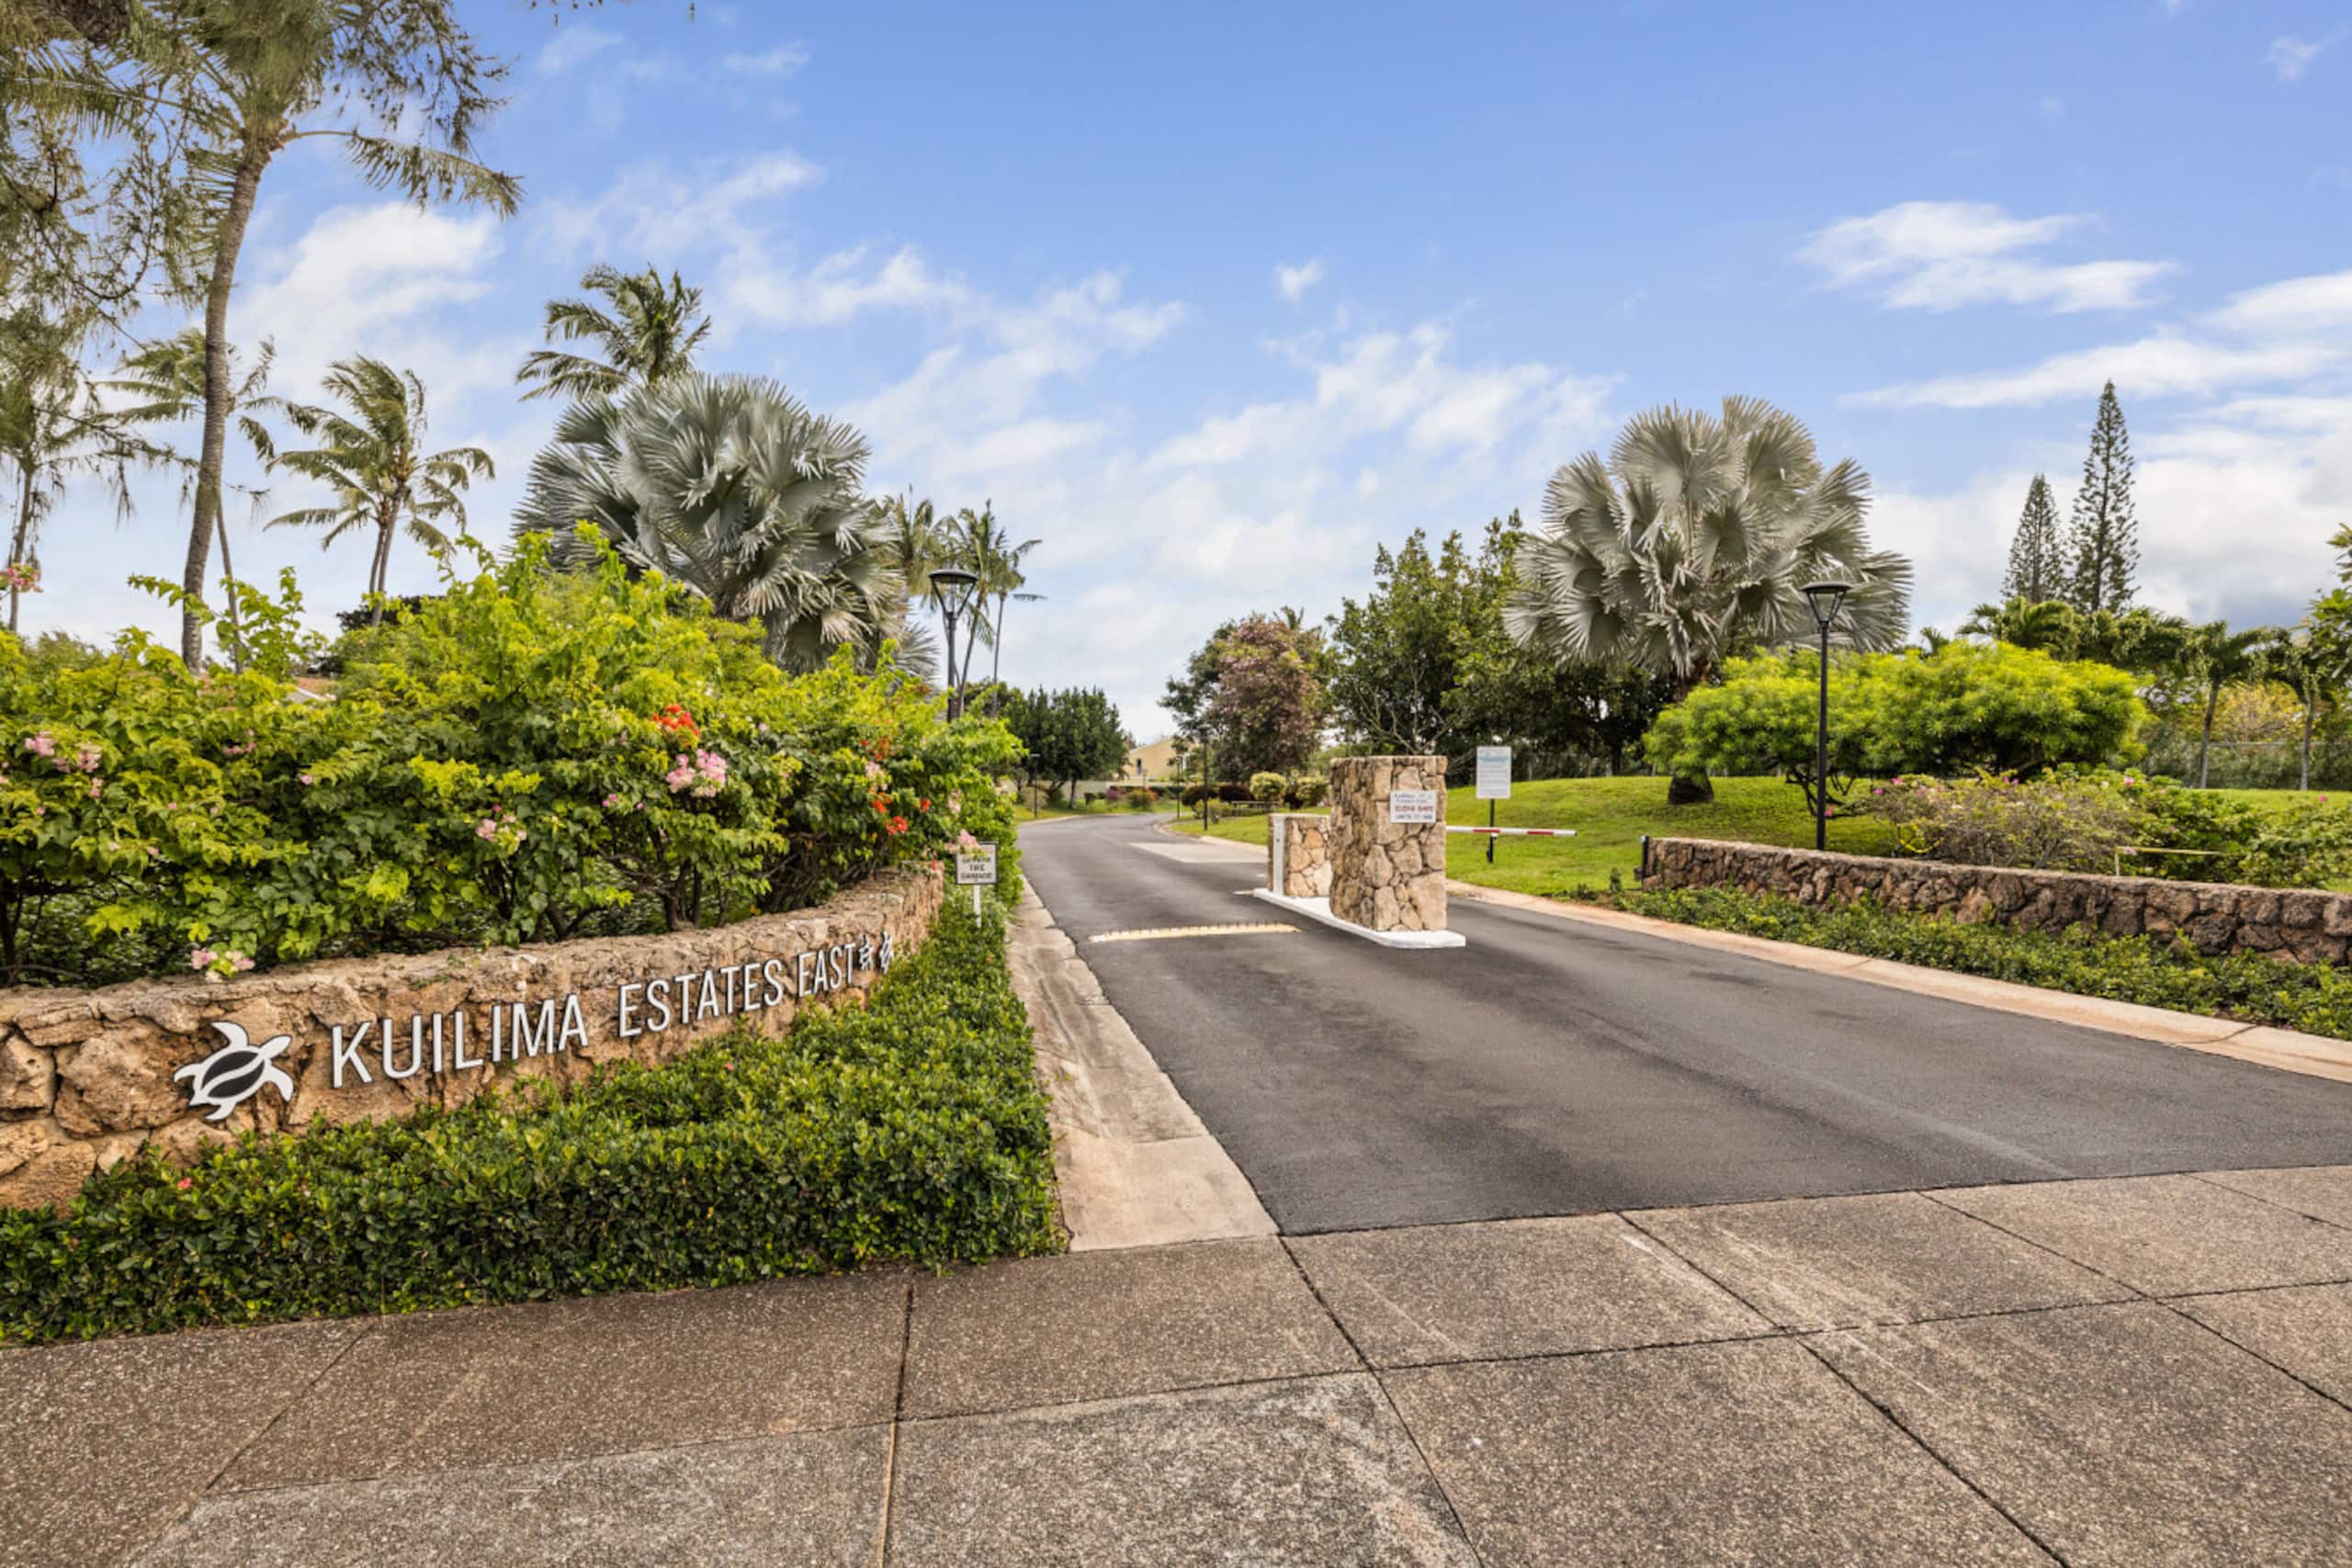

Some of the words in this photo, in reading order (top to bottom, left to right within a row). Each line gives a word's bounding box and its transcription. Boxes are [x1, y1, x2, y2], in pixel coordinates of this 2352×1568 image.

[331, 993, 588, 1089] KUILIMA
[618, 959, 784, 1038] ESTATES
[797, 942, 856, 998] EAST
